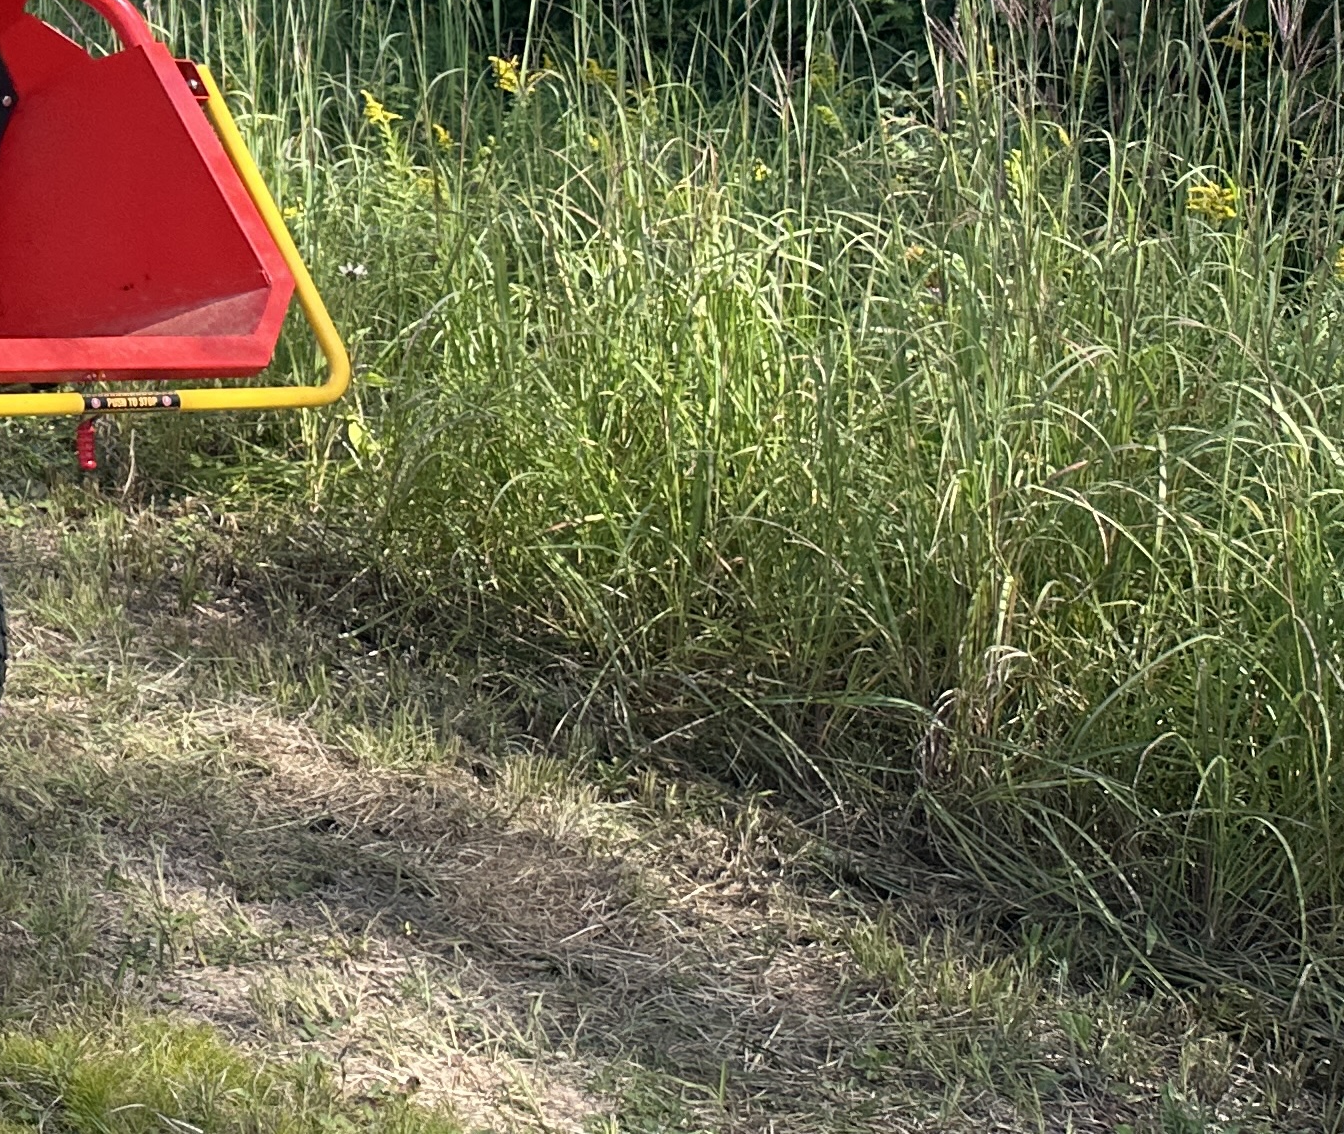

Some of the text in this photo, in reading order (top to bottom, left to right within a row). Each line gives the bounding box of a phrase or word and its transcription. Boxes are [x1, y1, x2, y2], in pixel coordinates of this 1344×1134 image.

[107, 396, 158, 408] PUSH TO STOP
